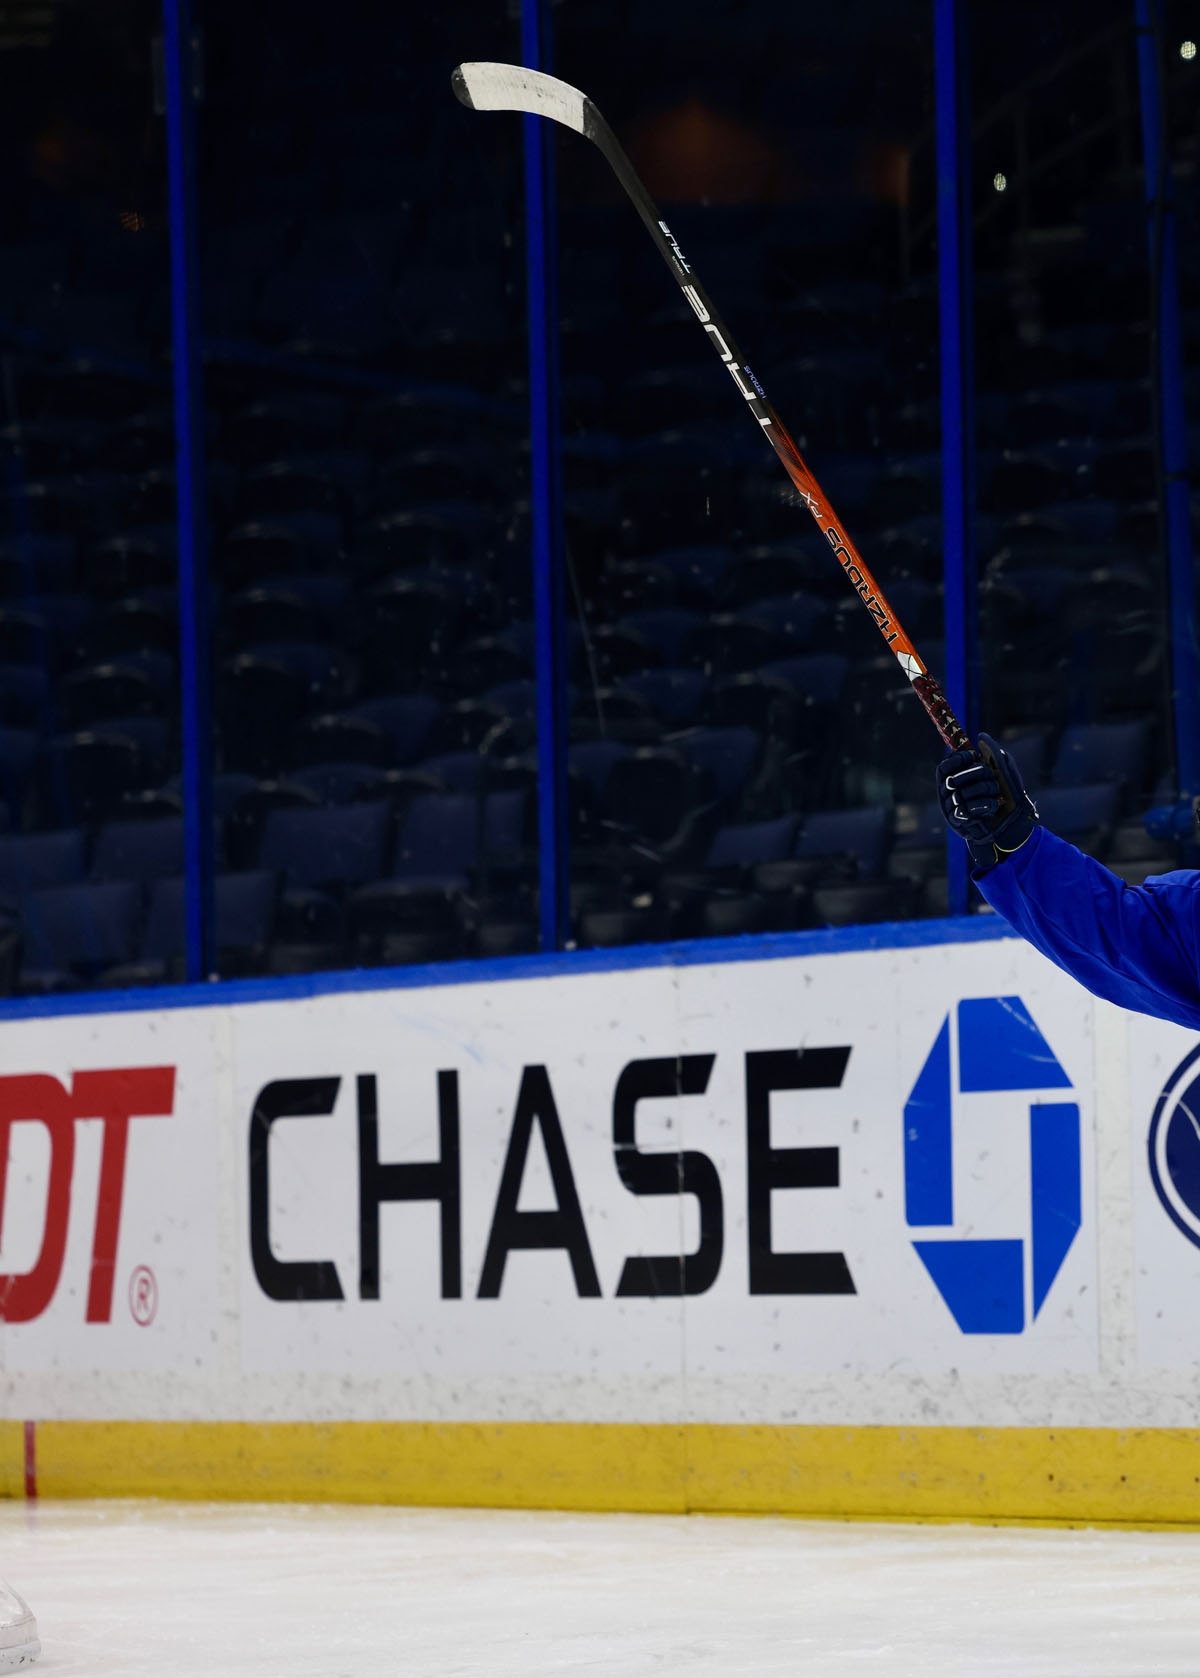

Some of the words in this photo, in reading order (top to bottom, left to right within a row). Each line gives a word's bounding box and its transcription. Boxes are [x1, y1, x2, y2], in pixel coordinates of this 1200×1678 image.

[658, 221, 691, 273] TRUE
[681, 284, 773, 445] TRUE
[824, 526, 899, 644] HZRDUS
[249, 1045, 858, 1302] CHASE
